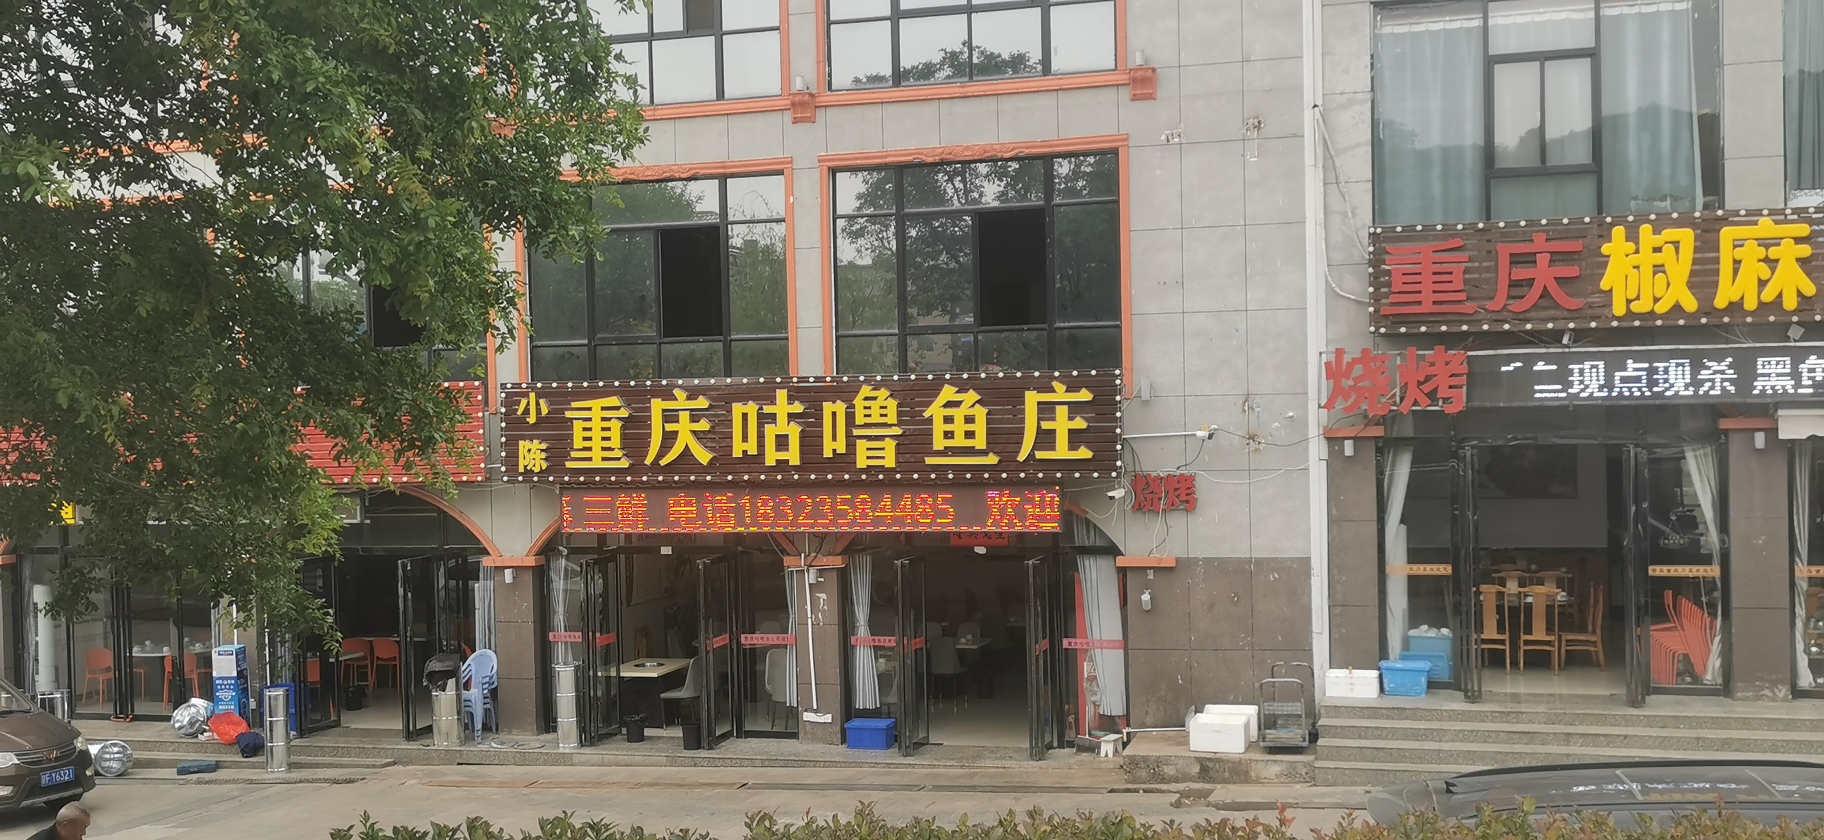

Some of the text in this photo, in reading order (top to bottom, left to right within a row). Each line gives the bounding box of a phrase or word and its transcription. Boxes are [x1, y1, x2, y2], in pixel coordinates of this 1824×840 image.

[1380, 217, 1817, 316] 重庆椒麻
[1322, 345, 1468, 415] 烧烤
[1501, 357, 1738, 397] 现点现杀
[516, 391, 549, 473] 小陈
[564, 380, 1095, 469] 重庆咕噜鱼庄
[562, 487, 1061, 531] 三鲜 电话18323584485 欢迎
[1131, 473, 1198, 513] 烧烤
